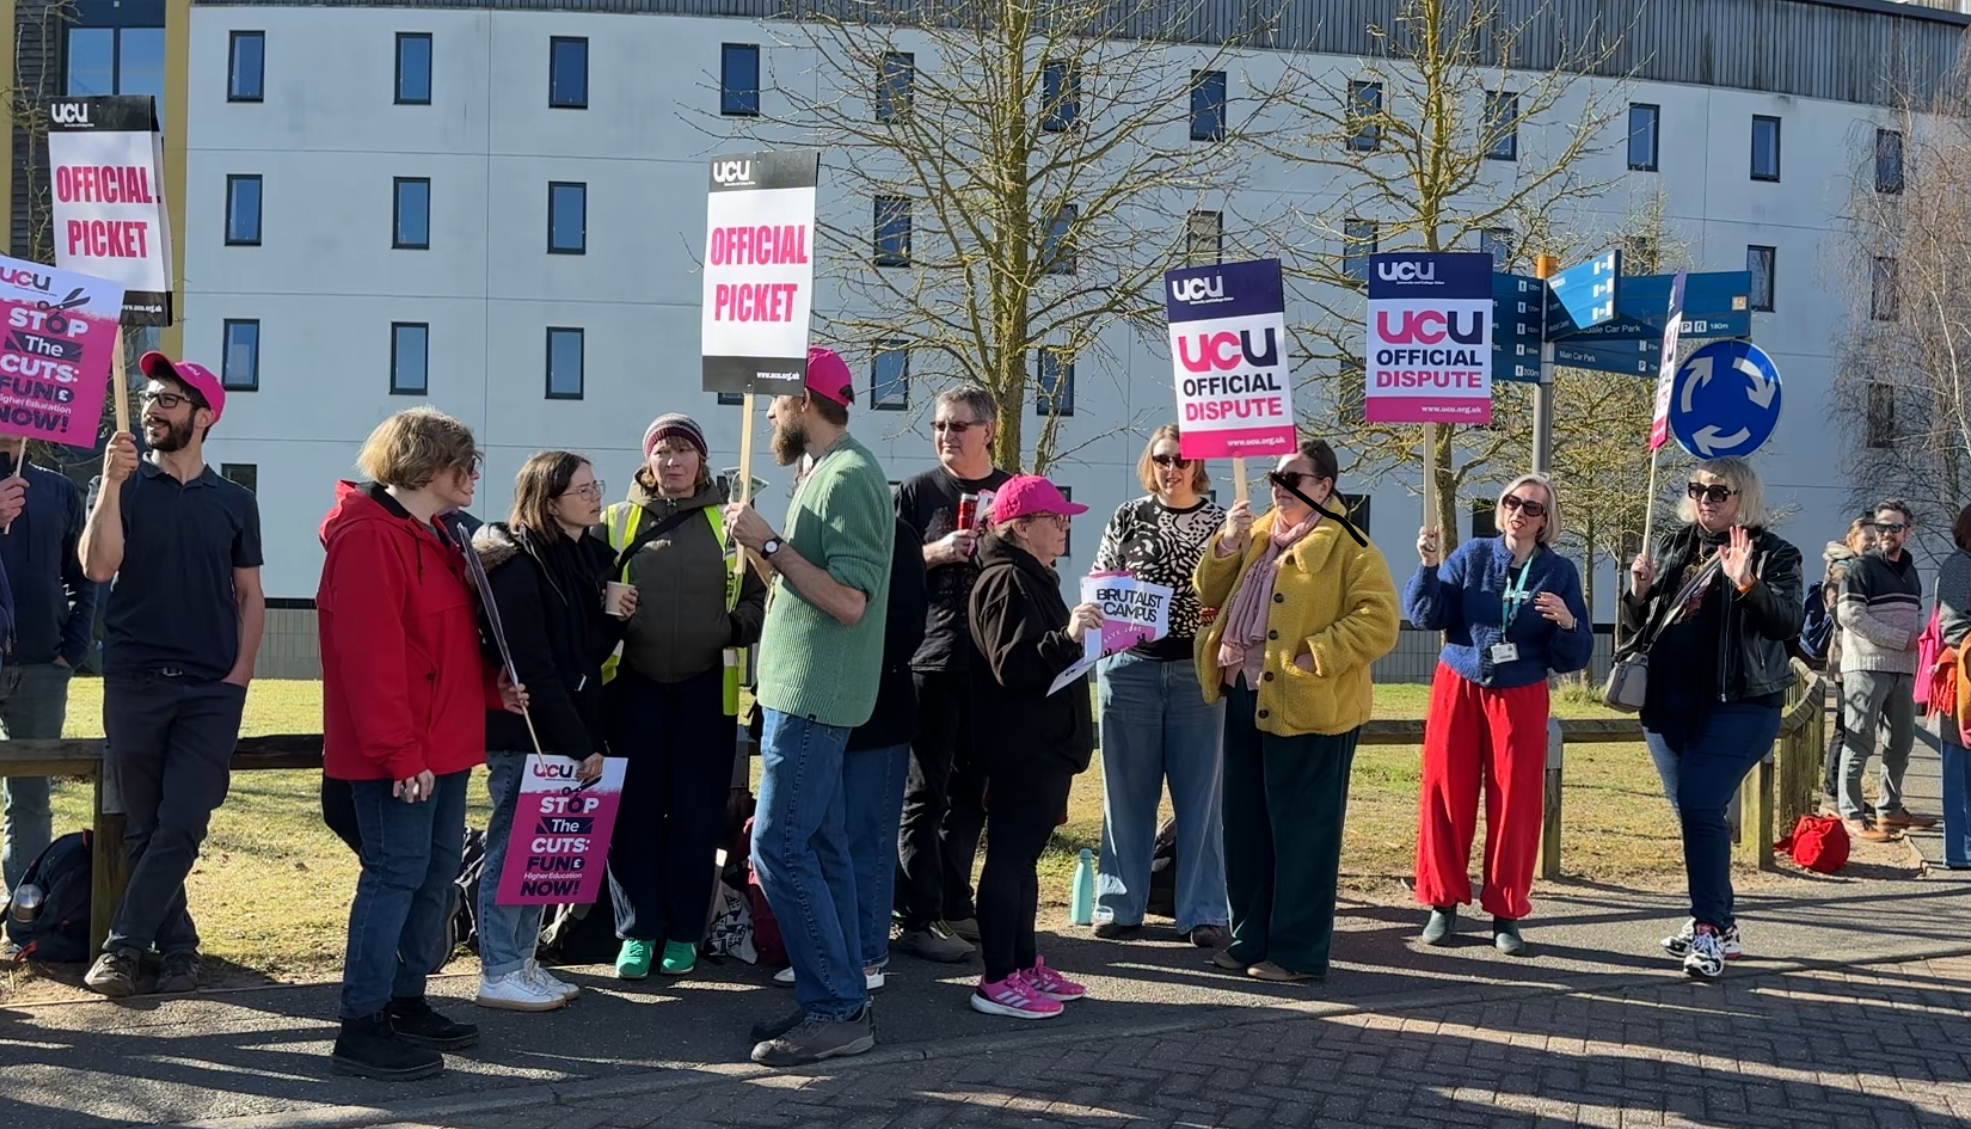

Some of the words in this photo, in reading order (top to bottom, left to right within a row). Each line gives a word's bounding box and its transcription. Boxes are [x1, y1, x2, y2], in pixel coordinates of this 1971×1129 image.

[56, 165, 153, 204] OFFICIAL
[67, 219, 147, 258] PICKET
[710, 225, 808, 266] OFFICIAL
[714, 282, 798, 323] PICKET
[8, 306, 89, 338] STOP
[1604, 325, 1620, 333] Car
[1621, 324, 1642, 333] Park
[25, 335, 64, 357] The
[1376, 349, 1483, 366] OFFICIAL
[1583, 353, 1597, 363] Park
[0, 354, 80, 383] CUTS:
[1183, 373, 1282, 397] OFFICIAL
[1376, 370, 1482, 388] DISPUTE
[1185, 397, 1283, 422] DISPUTE
[1421, 405, 1482, 414] www.ucu.org.uk
[1227, 436, 1286, 447] www.ucu.org.uk
[1096, 588, 1164, 609] BRUTALIST
[1103, 601, 1157, 622] CAMPUS
[539, 796, 600, 815] STOP
[552, 819, 580, 833] The
[531, 837, 591, 853] CUTS:
[523, 872, 548, 880] Higher
[519, 880, 581, 896] NOW!
